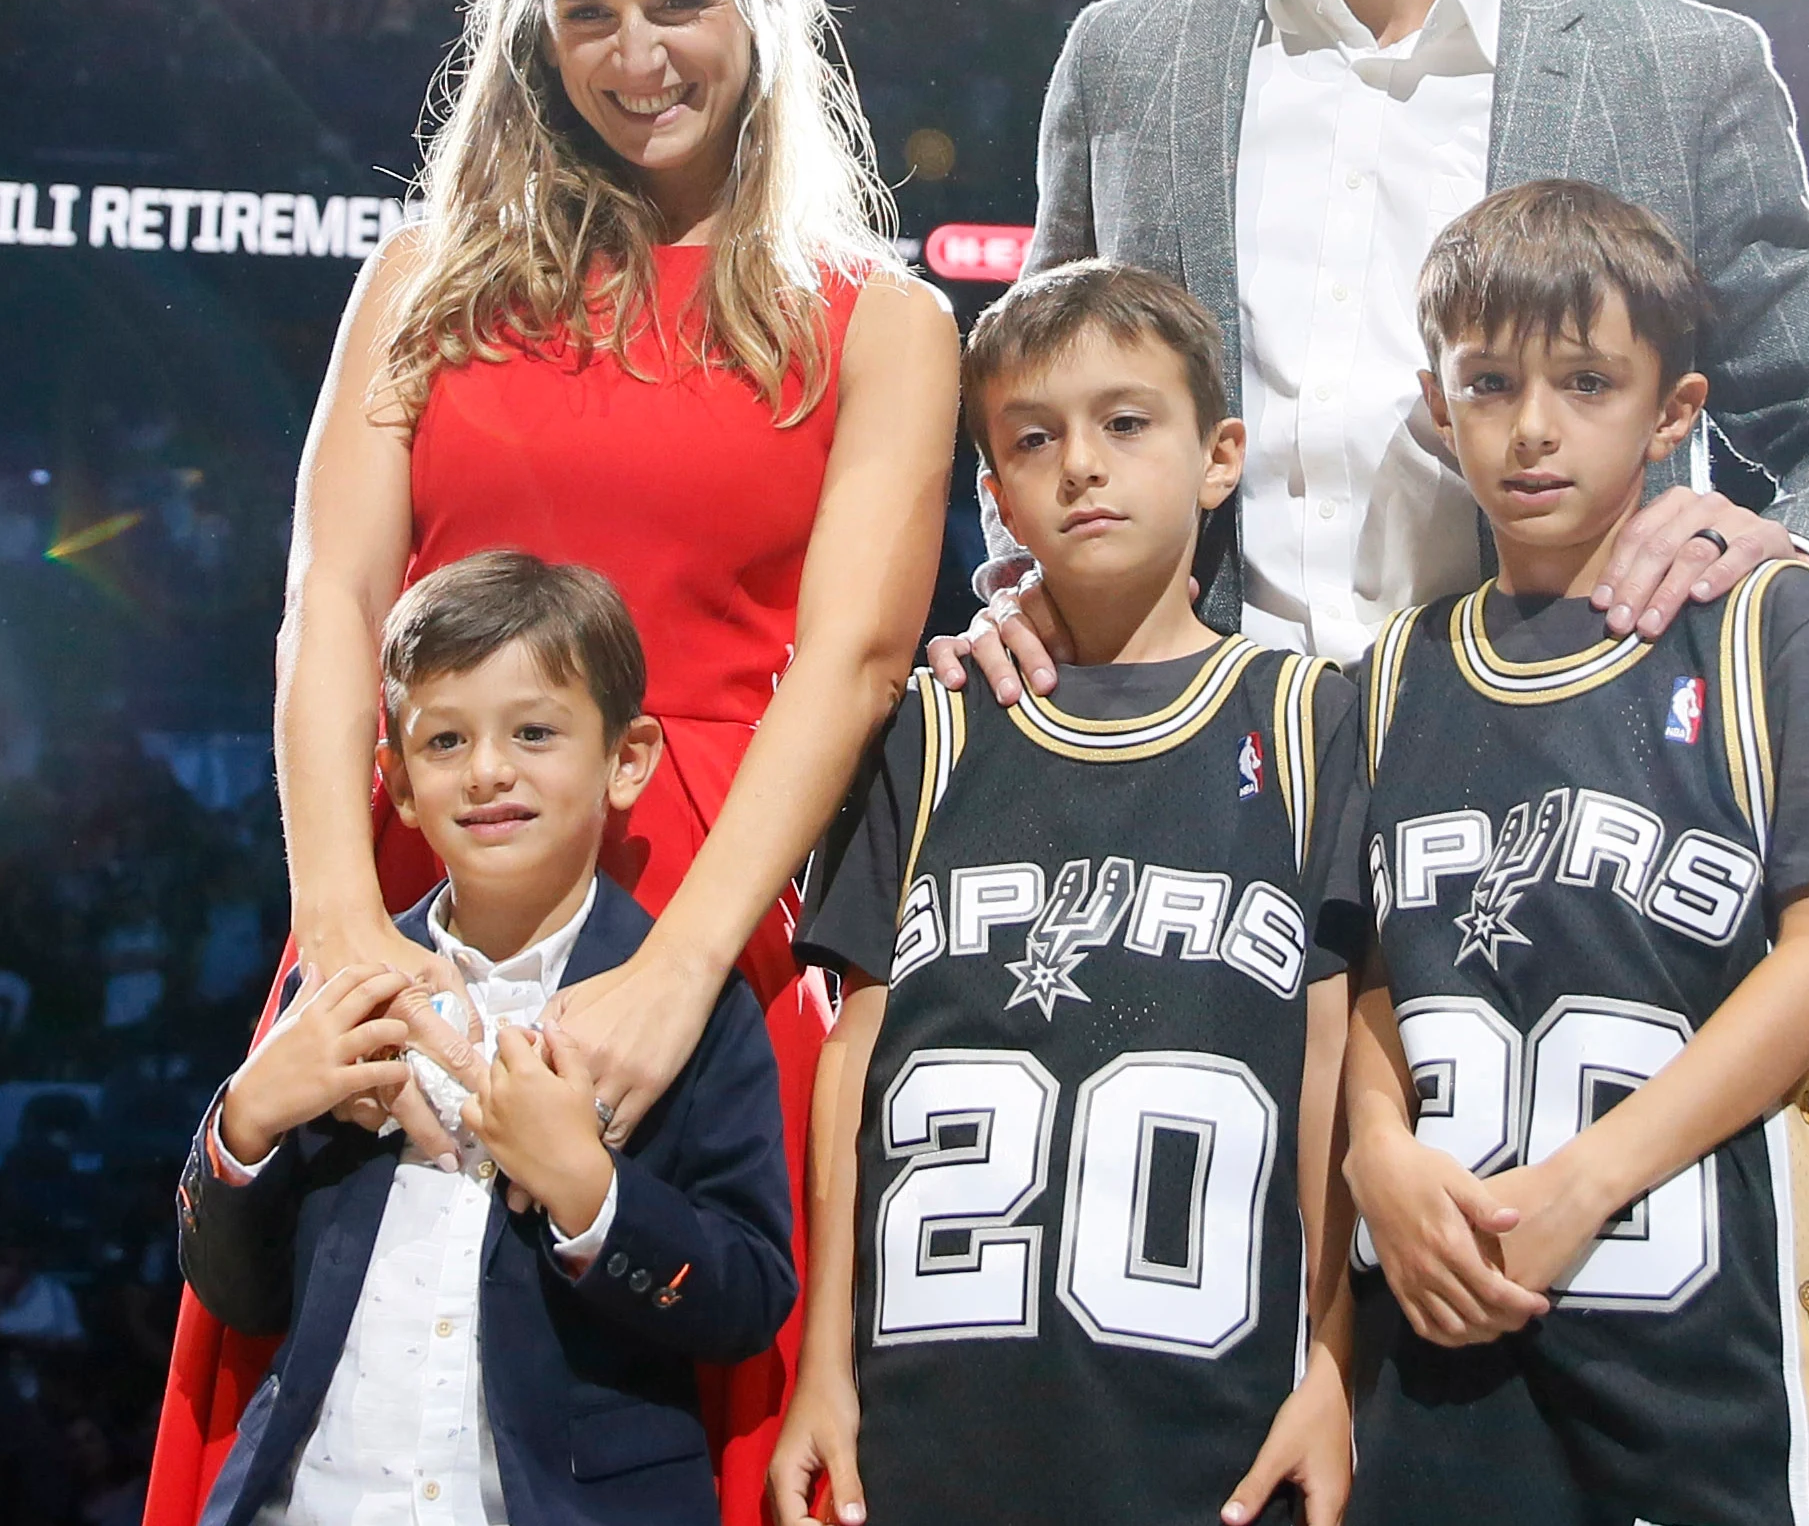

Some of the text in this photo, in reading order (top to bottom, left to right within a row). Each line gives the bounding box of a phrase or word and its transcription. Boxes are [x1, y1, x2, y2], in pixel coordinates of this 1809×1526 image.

[888, 856, 1307, 1001] SPURS
[1368, 788, 1760, 948] PURS
[872, 1048, 1279, 1360] 20
